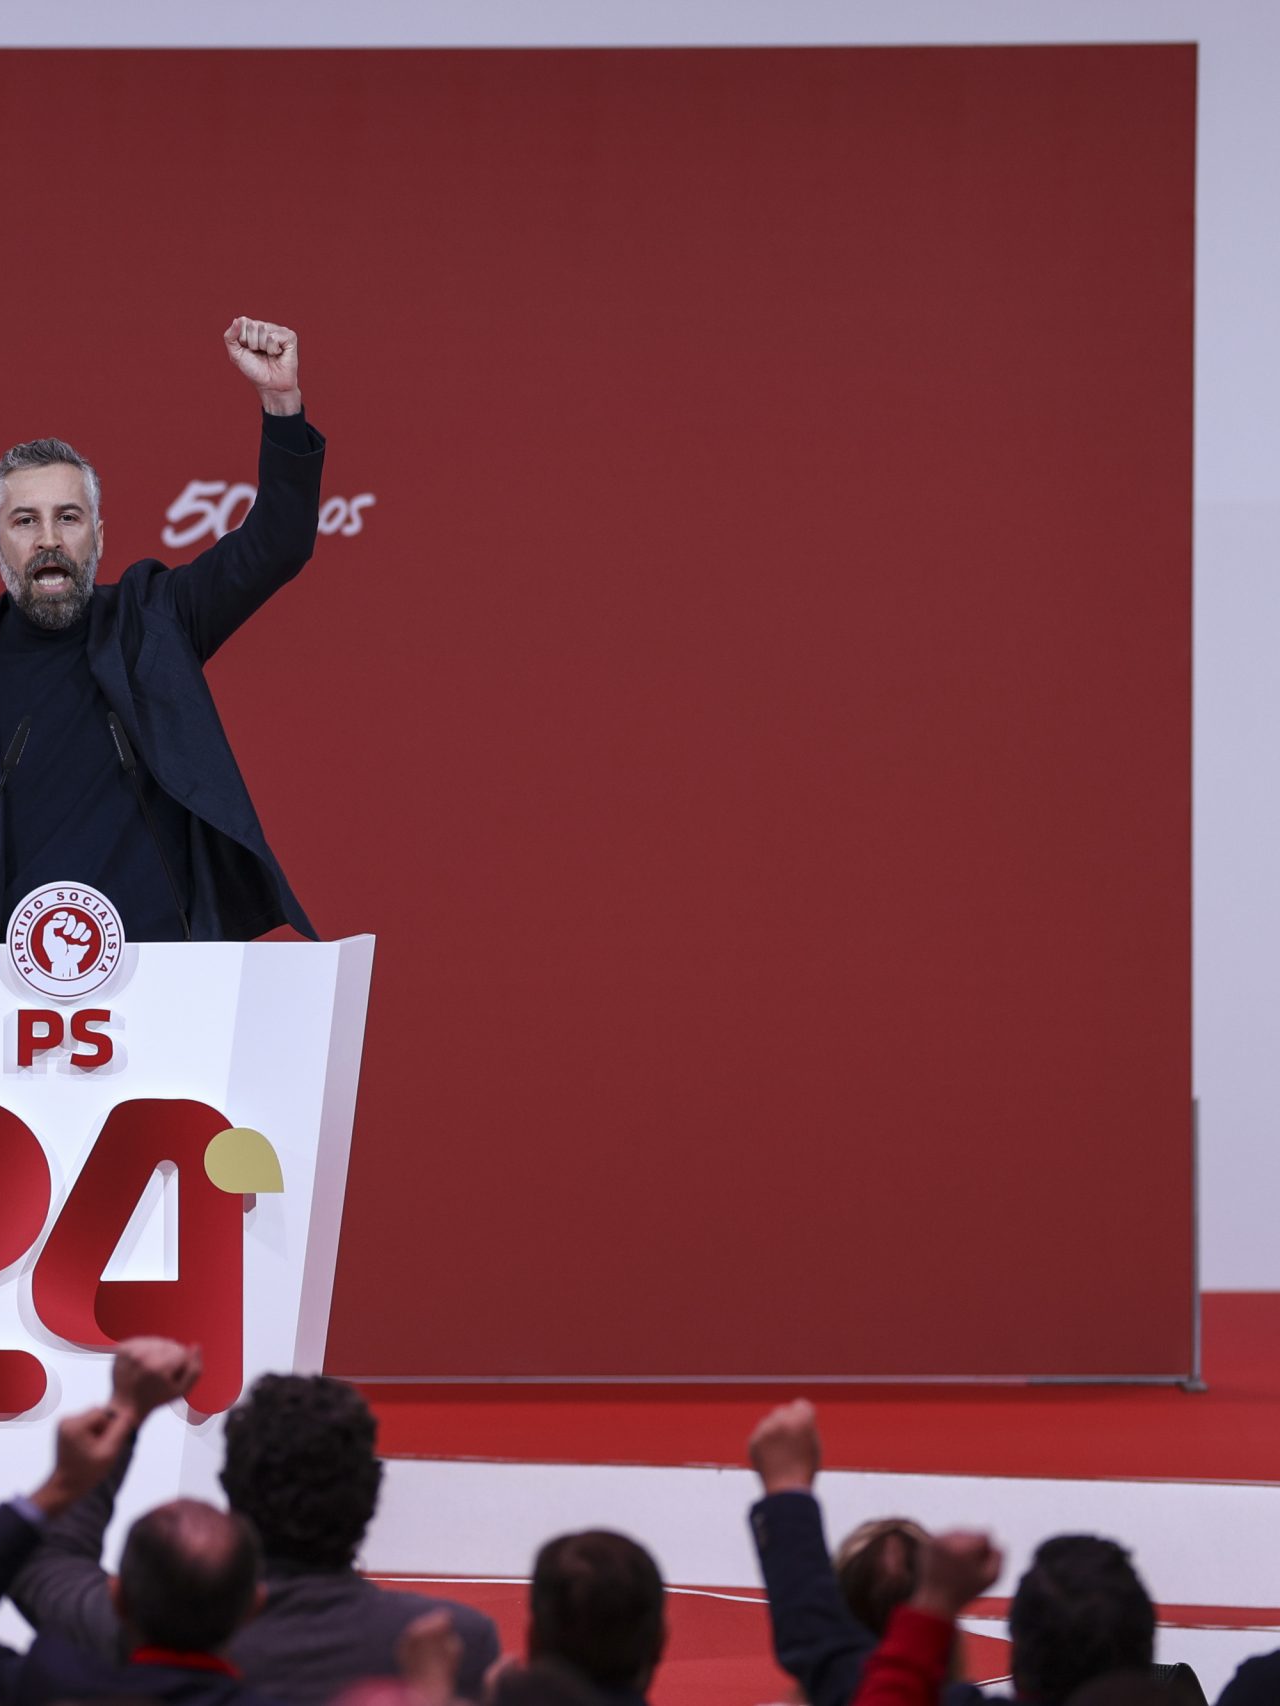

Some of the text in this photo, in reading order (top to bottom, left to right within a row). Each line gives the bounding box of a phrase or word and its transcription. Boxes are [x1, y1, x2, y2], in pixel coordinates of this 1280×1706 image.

[162, 480, 375, 548] 50 os
[15, 891, 117, 975] PARTIDO SOCIALISTA
[17, 1008, 113, 1068] PS
